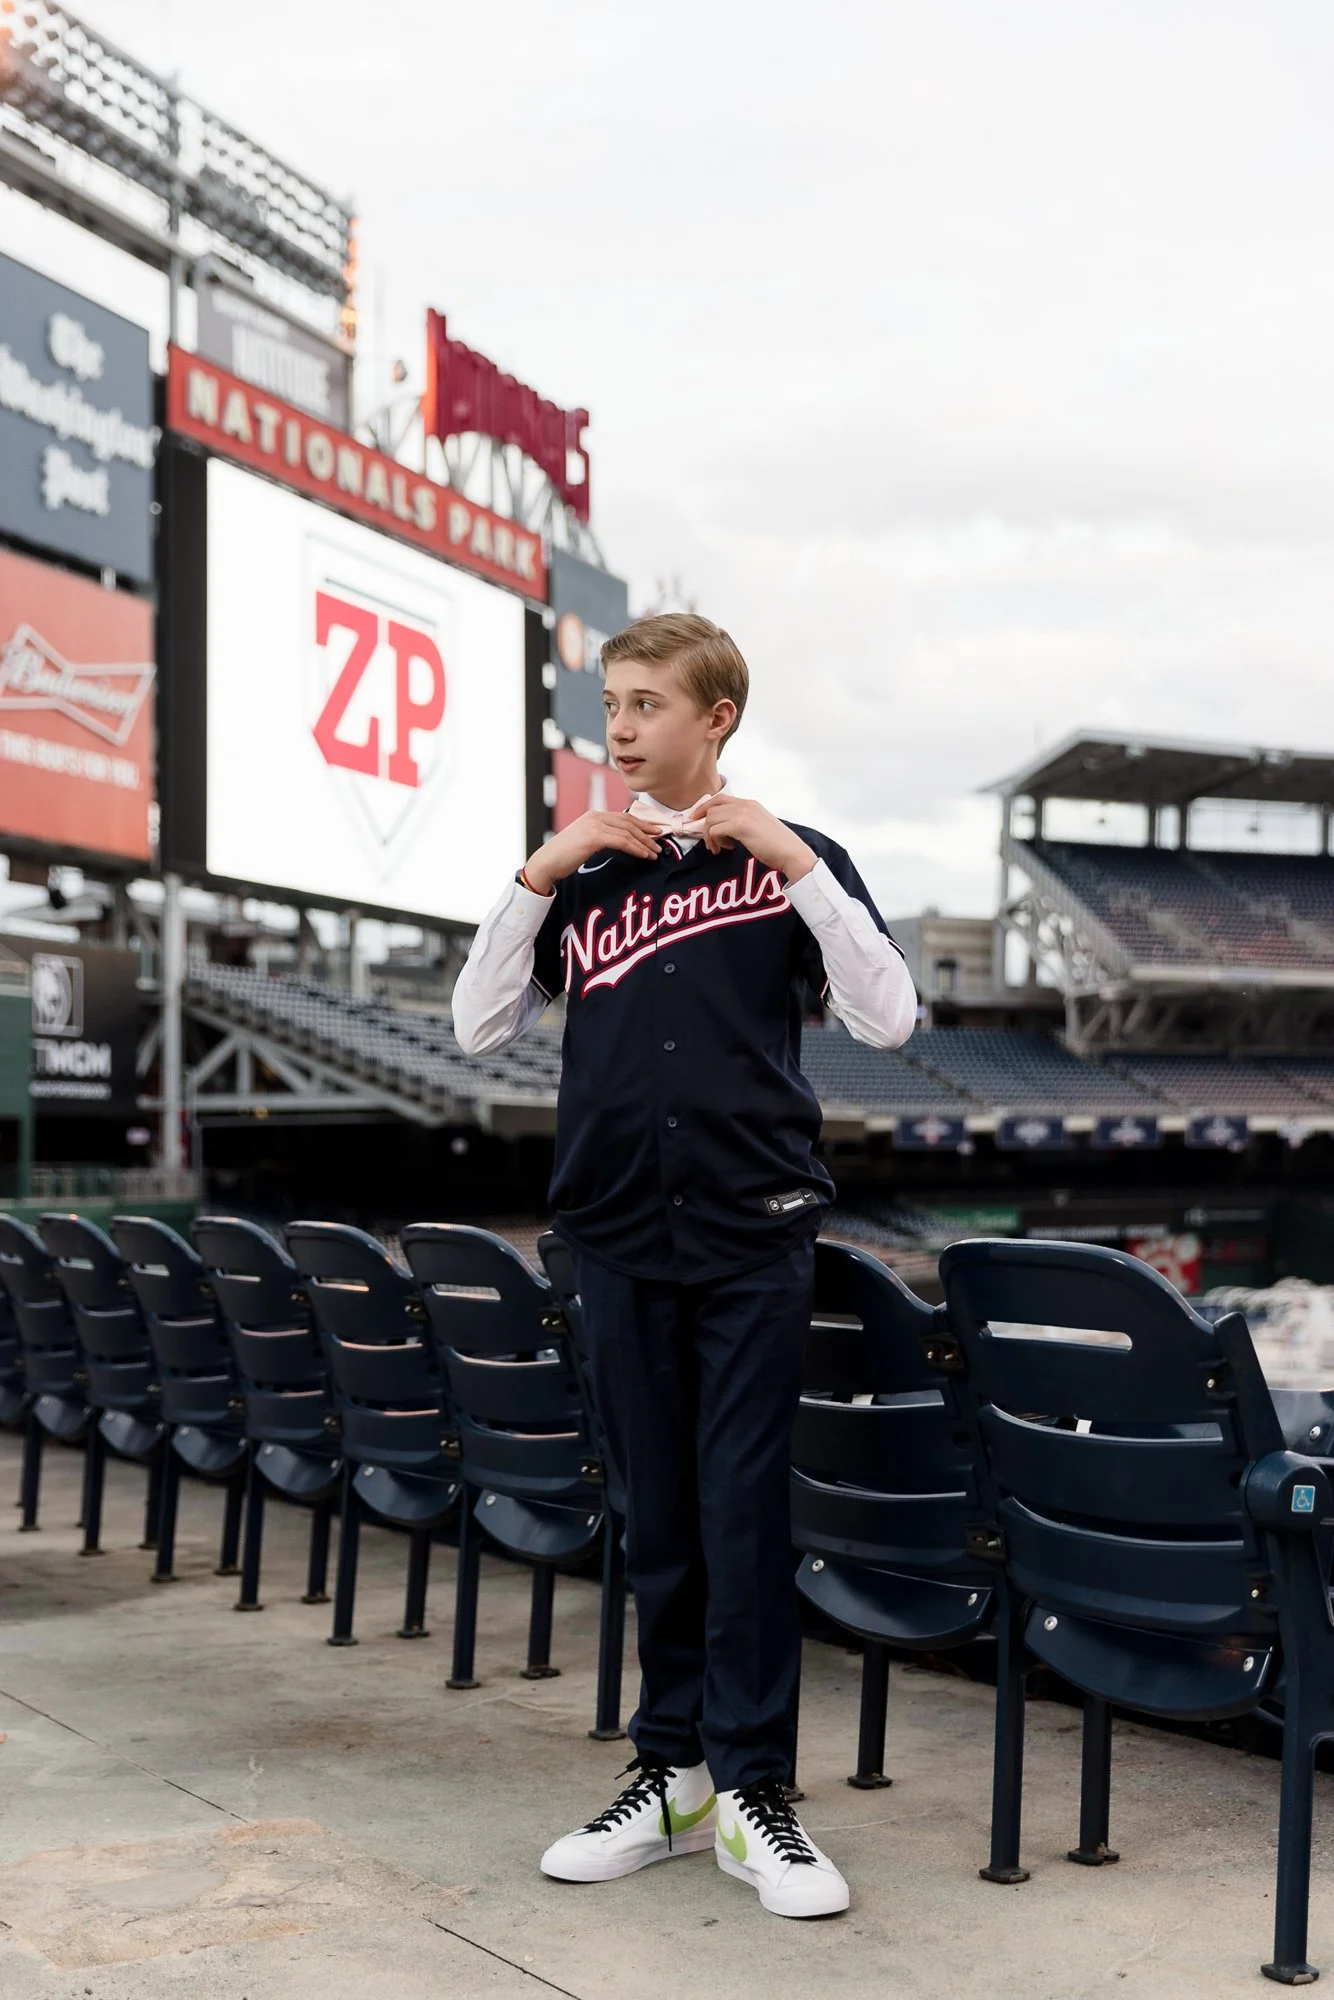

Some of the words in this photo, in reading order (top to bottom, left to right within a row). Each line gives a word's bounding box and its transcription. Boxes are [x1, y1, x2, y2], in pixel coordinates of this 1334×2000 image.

[187, 367, 437, 532] NATIONALS
[447, 502, 537, 582] PARK
[312, 590, 446, 788] ZP
[559, 856, 789, 996] Nationals
